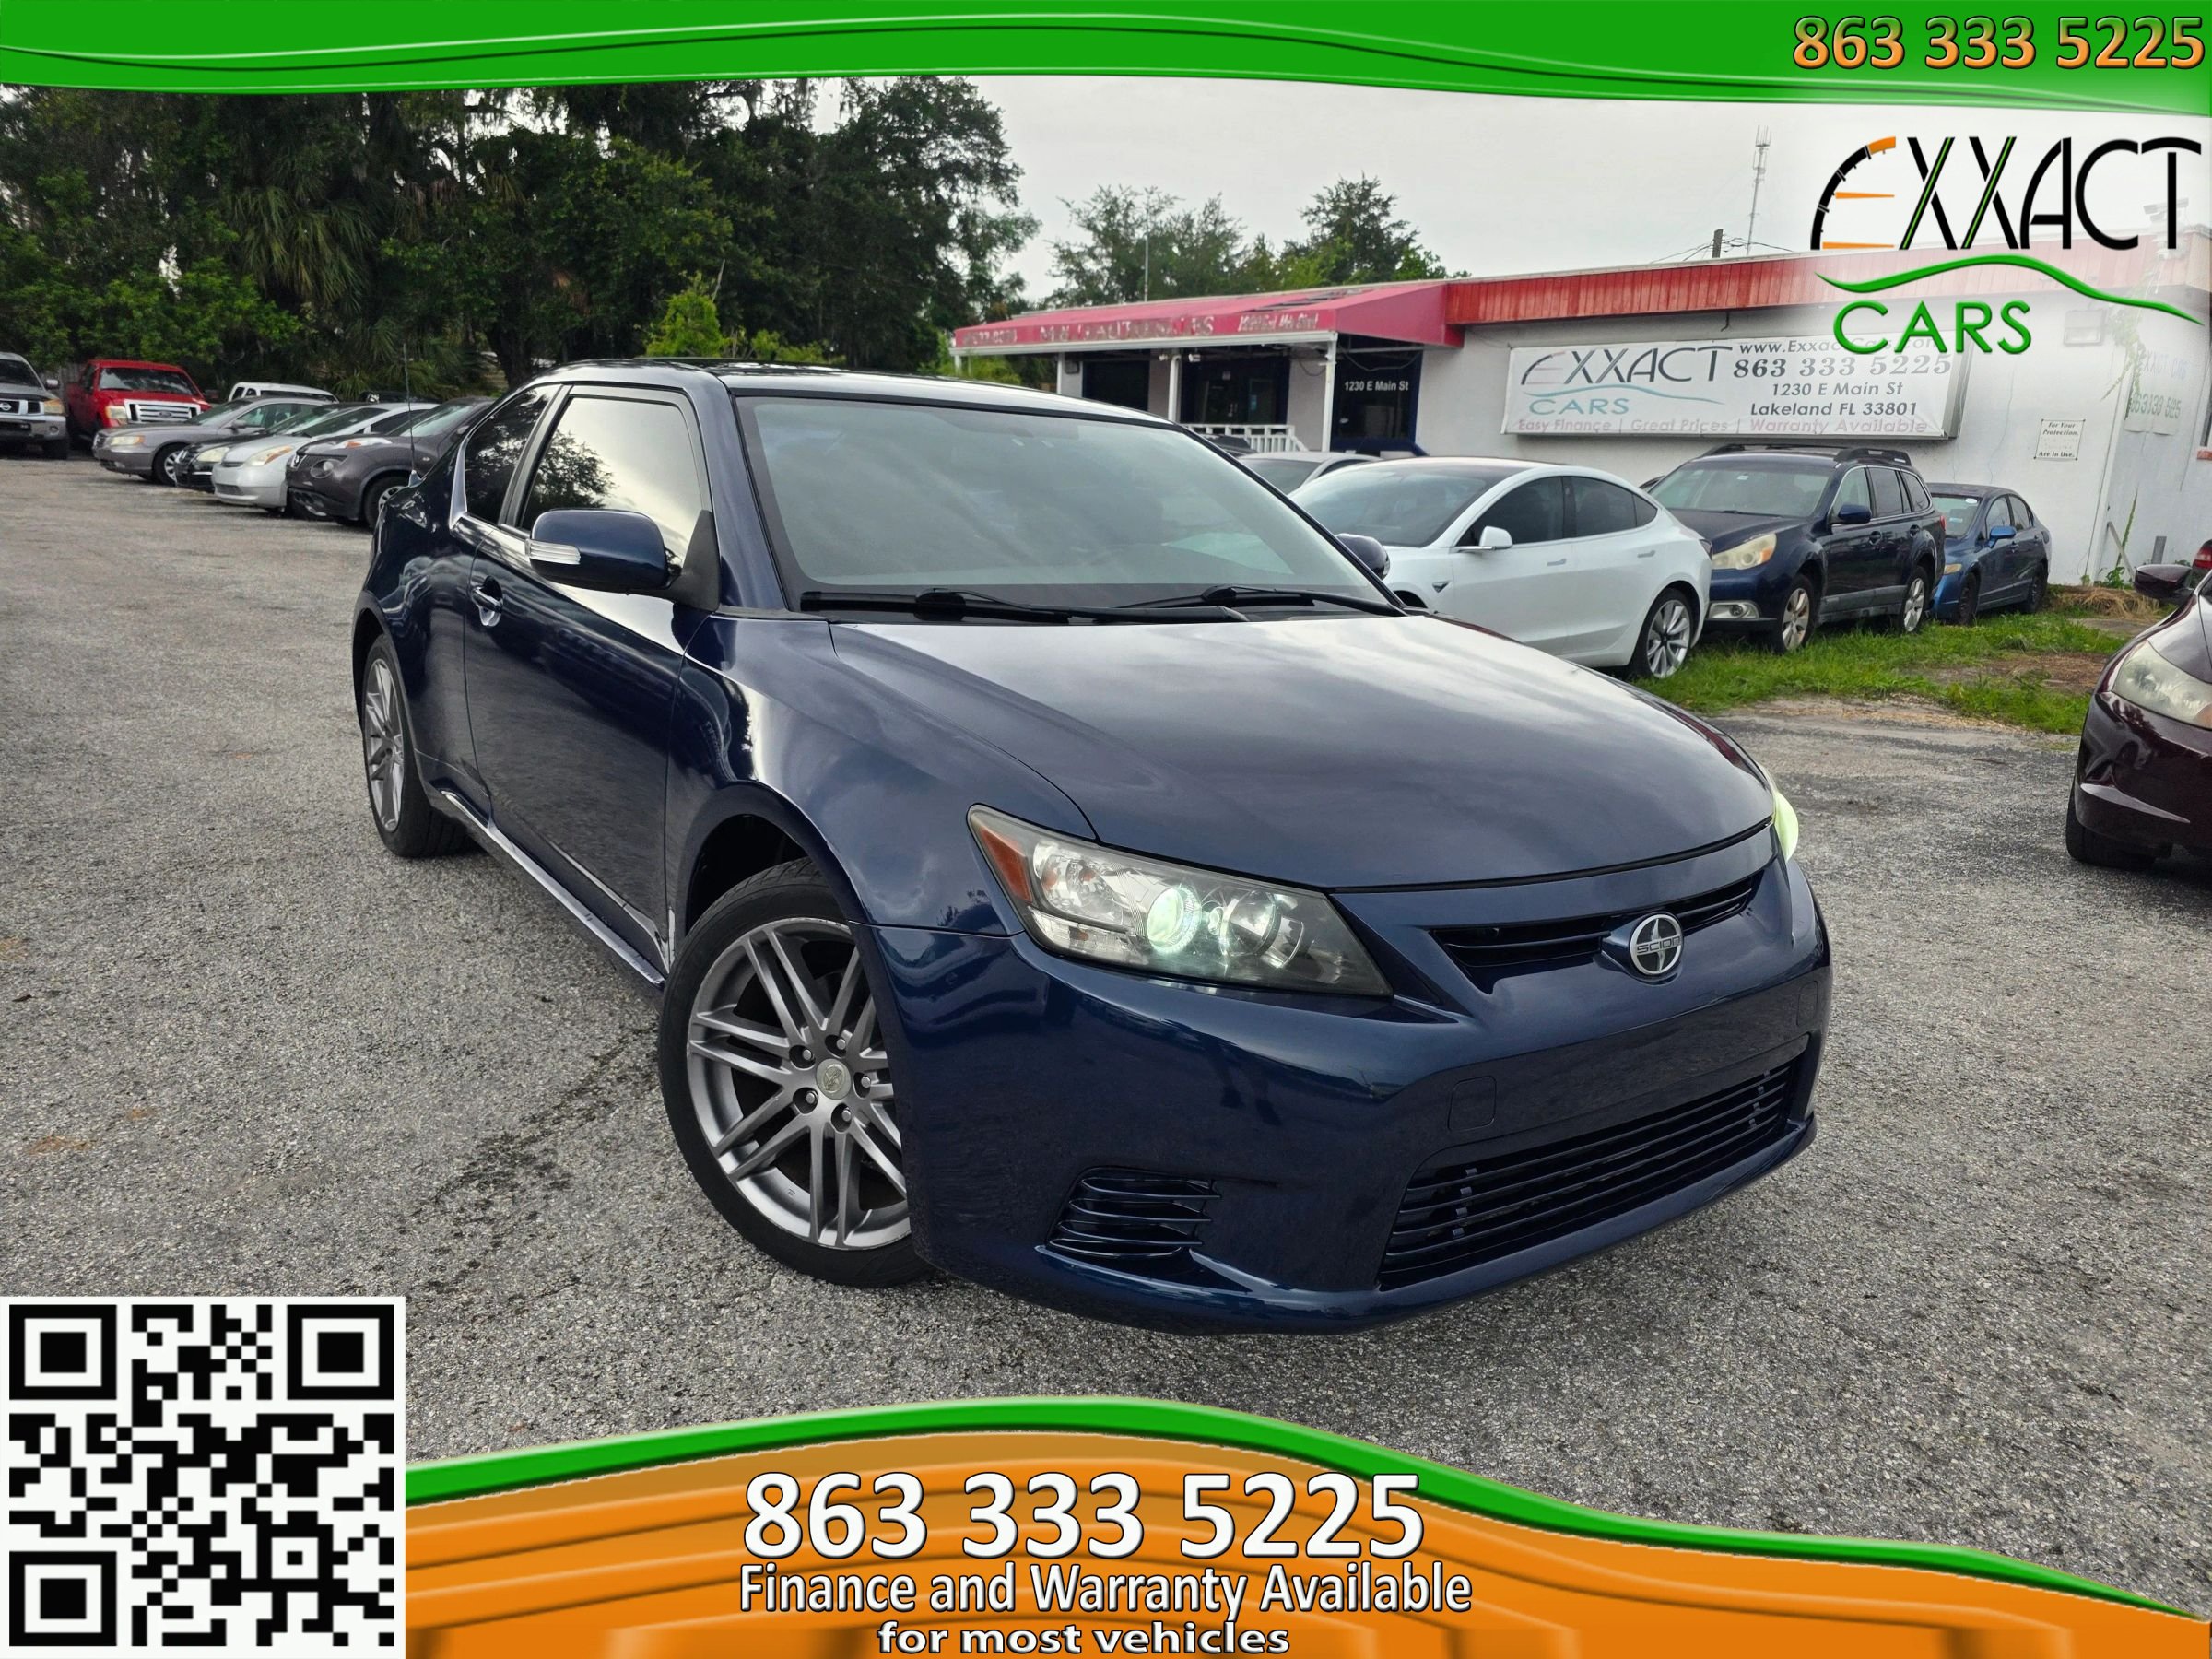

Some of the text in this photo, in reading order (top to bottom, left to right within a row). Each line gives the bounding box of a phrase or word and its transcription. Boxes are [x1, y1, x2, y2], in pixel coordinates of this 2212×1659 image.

[1521, 345, 1734, 385] EXXACT
[1733, 354, 1951, 378] 863 333 5225
[1345, 380, 1409, 391] 1230 E Main St
[1772, 382, 1903, 396] 1230 E Main St
[1529, 398, 1630, 416] CARS
[1750, 402, 1917, 417] Lakeland FL 33801
[1518, 418, 1611, 433] Easy Finance
[1630, 418, 1728, 433] Great Prices
[1751, 418, 1927, 435] Warranty Available
[1637, 935, 1681, 954] SCION
